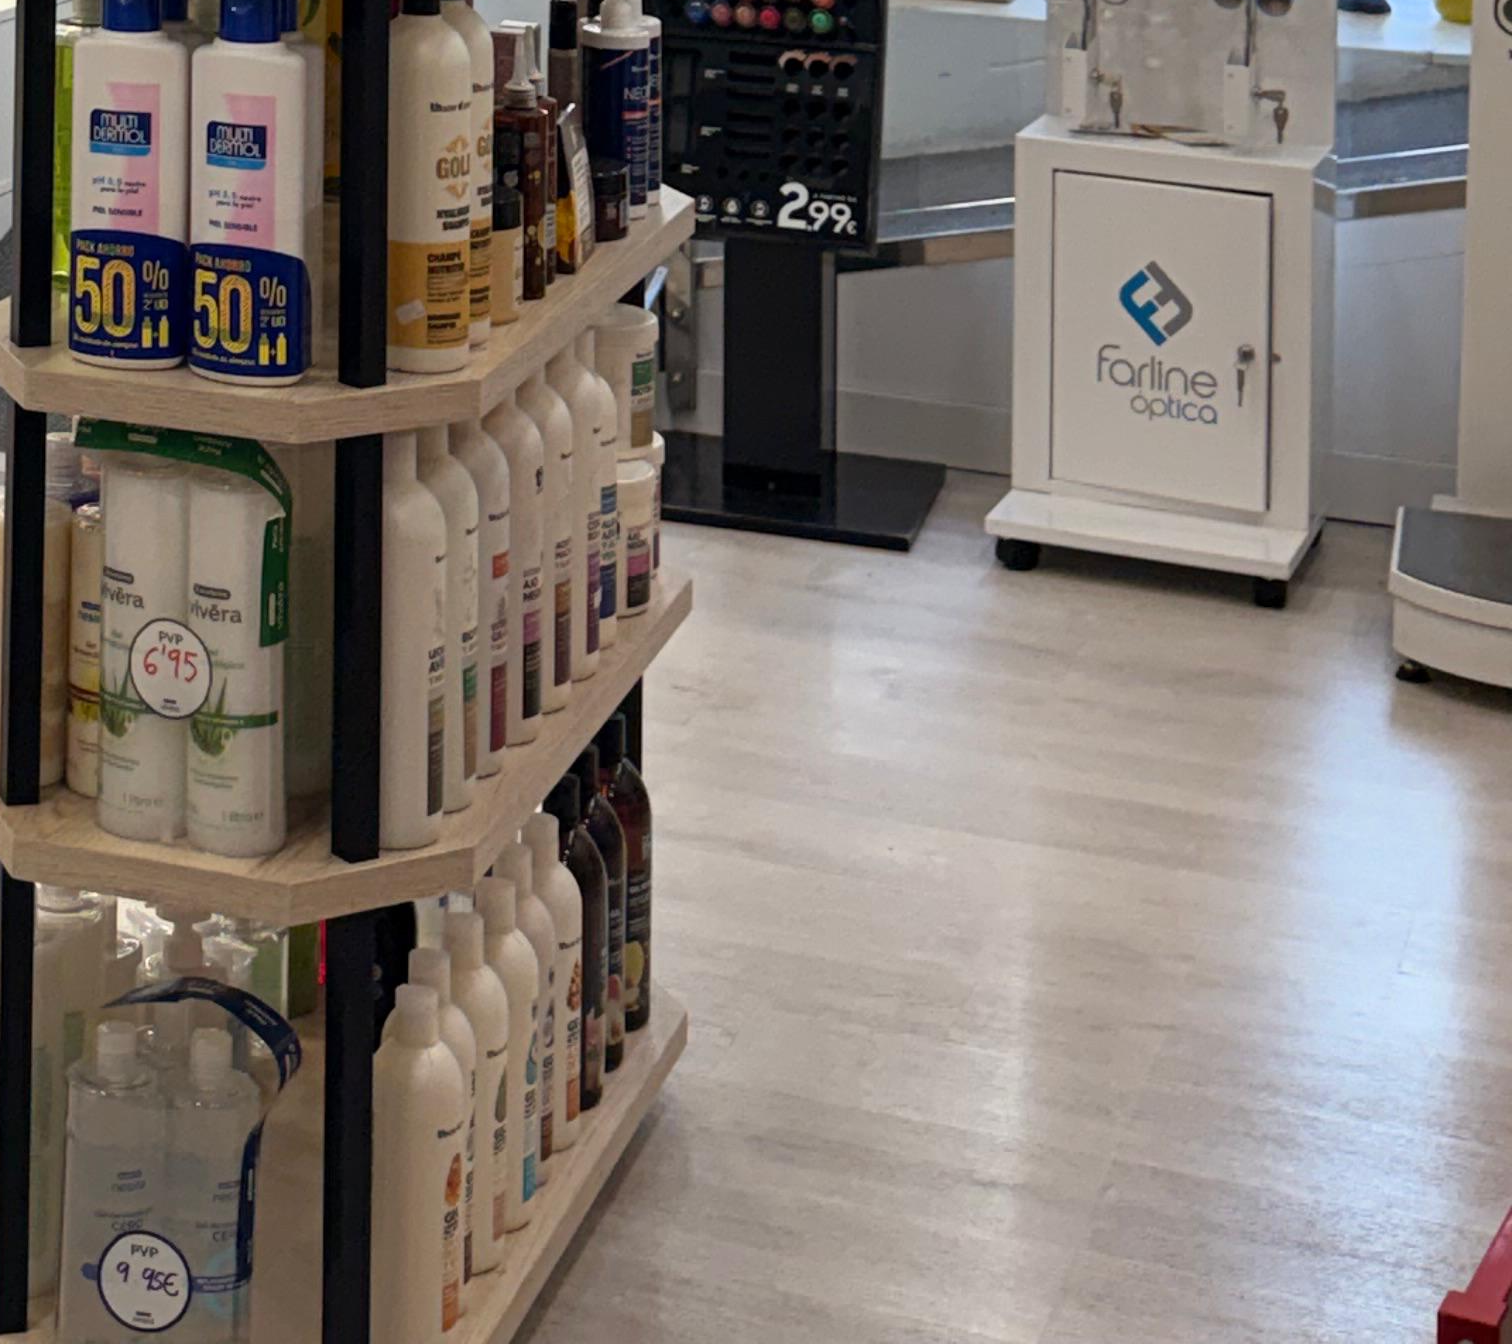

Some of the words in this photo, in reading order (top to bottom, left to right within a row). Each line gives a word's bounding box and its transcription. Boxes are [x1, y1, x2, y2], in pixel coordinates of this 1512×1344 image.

[100, 112, 139, 129] MULTI
[93, 125, 146, 144] DERMOL
[215, 125, 254, 143] MULTI
[209, 137, 261, 158] DERMOL
[74, 254, 137, 338] 50
[142, 259, 170, 291] %
[193, 267, 254, 354] 50
[259, 275, 287, 308] %
[1096, 344, 1218, 399] farline
[1130, 389, 1218, 425] óptica
[158, 630, 184, 645] PVP
[130, 1243, 159, 1258] PVP
